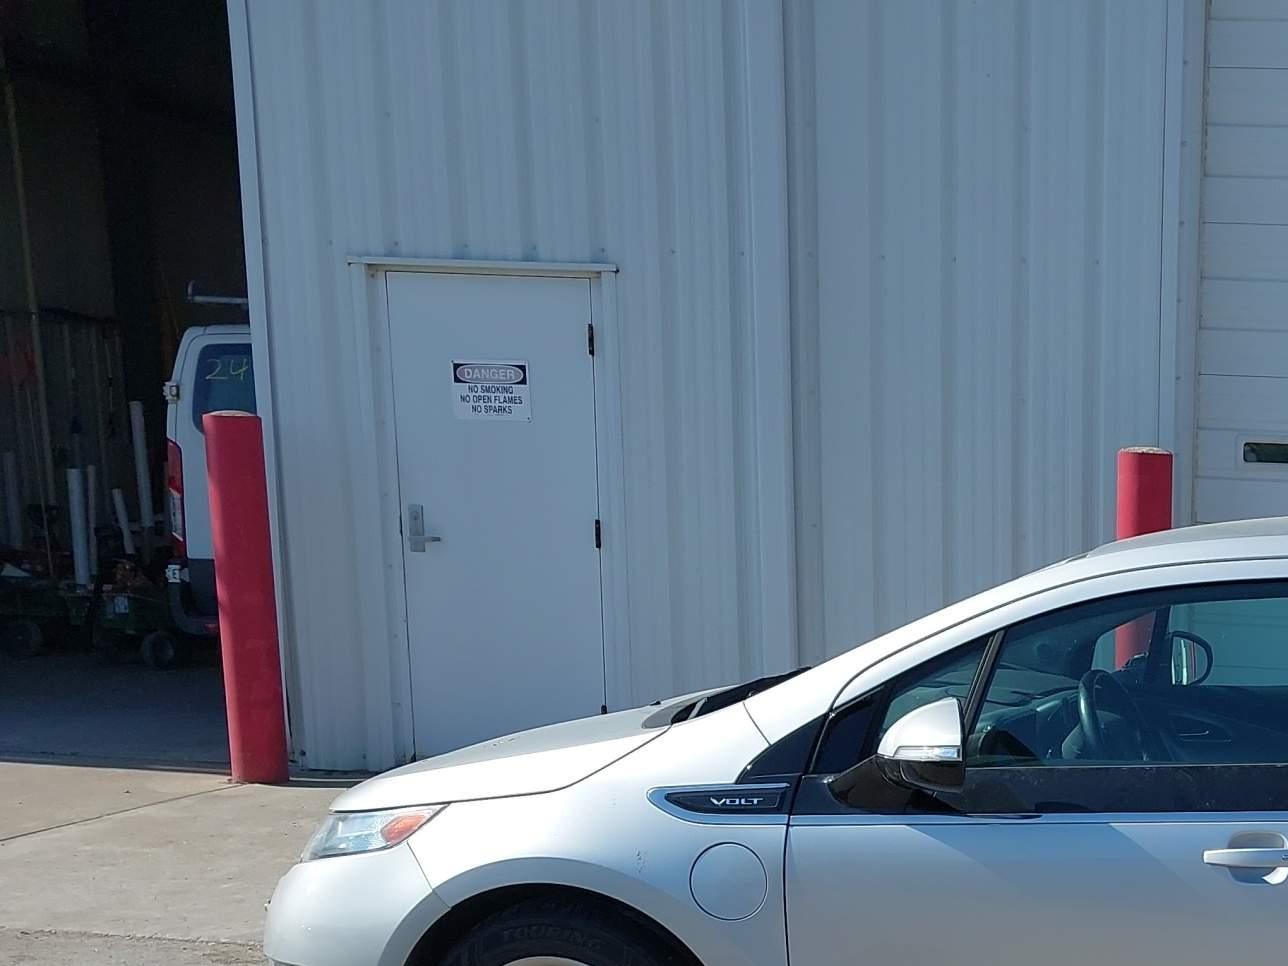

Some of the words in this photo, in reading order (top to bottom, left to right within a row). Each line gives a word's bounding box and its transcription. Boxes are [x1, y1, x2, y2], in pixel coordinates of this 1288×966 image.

[464, 368, 515, 380] DANGER
[468, 385, 479, 393] NO
[480, 385, 514, 394] SMOKING
[460, 394, 471, 403] NO
[472, 394, 492, 404] OPEN
[494, 395, 523, 405] FLAMES
[471, 405, 482, 413] NO
[483, 405, 513, 414] SPARKS
[710, 797, 764, 805] VOLT
